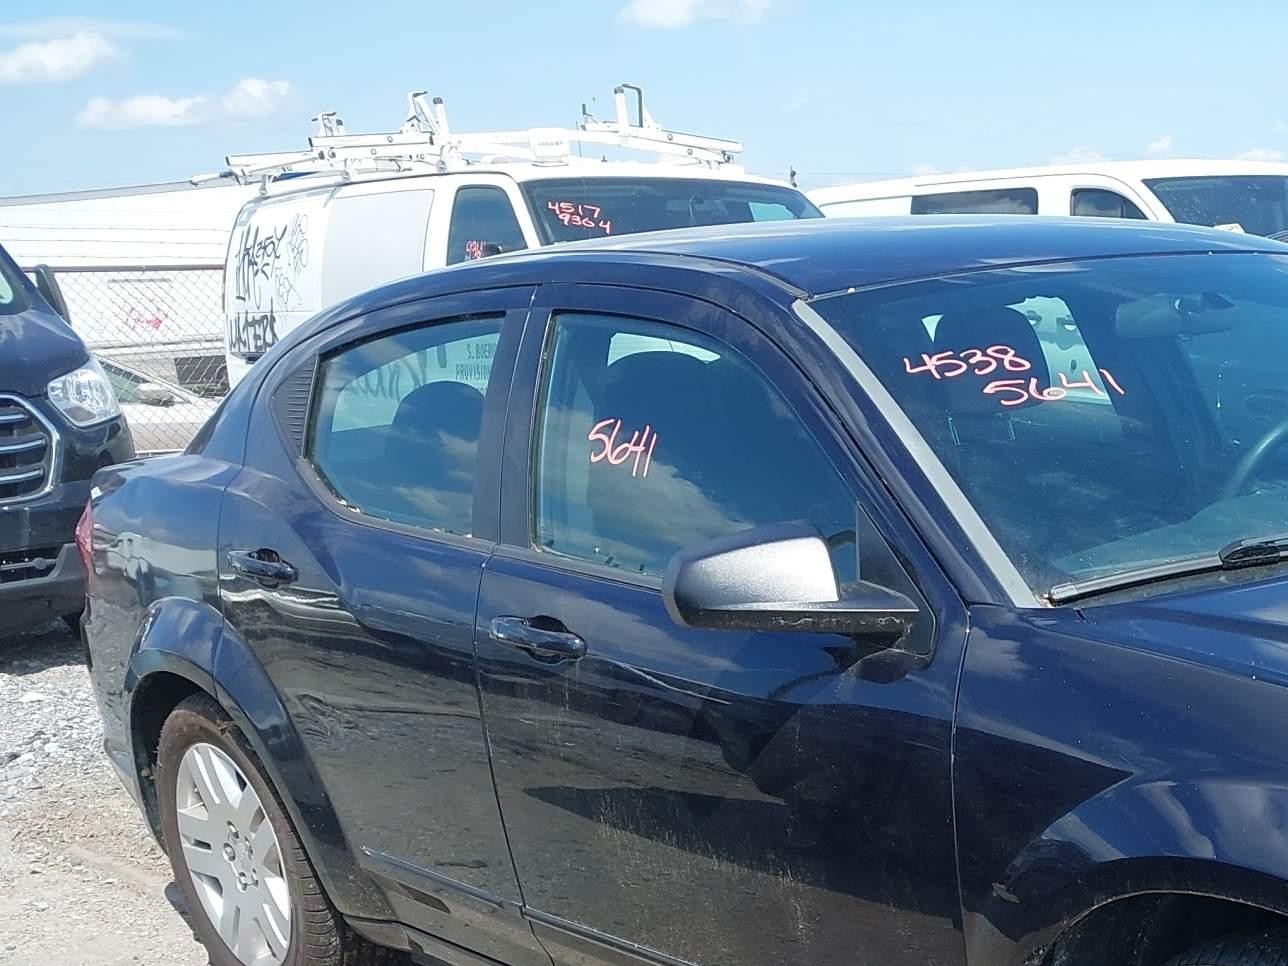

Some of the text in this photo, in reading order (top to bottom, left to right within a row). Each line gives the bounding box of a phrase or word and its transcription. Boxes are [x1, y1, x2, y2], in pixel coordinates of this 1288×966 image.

[547, 201, 601, 219] 4517
[903, 345, 1032, 380] 4538
[982, 368, 1126, 406] 5641
[588, 418, 657, 478] 5641
